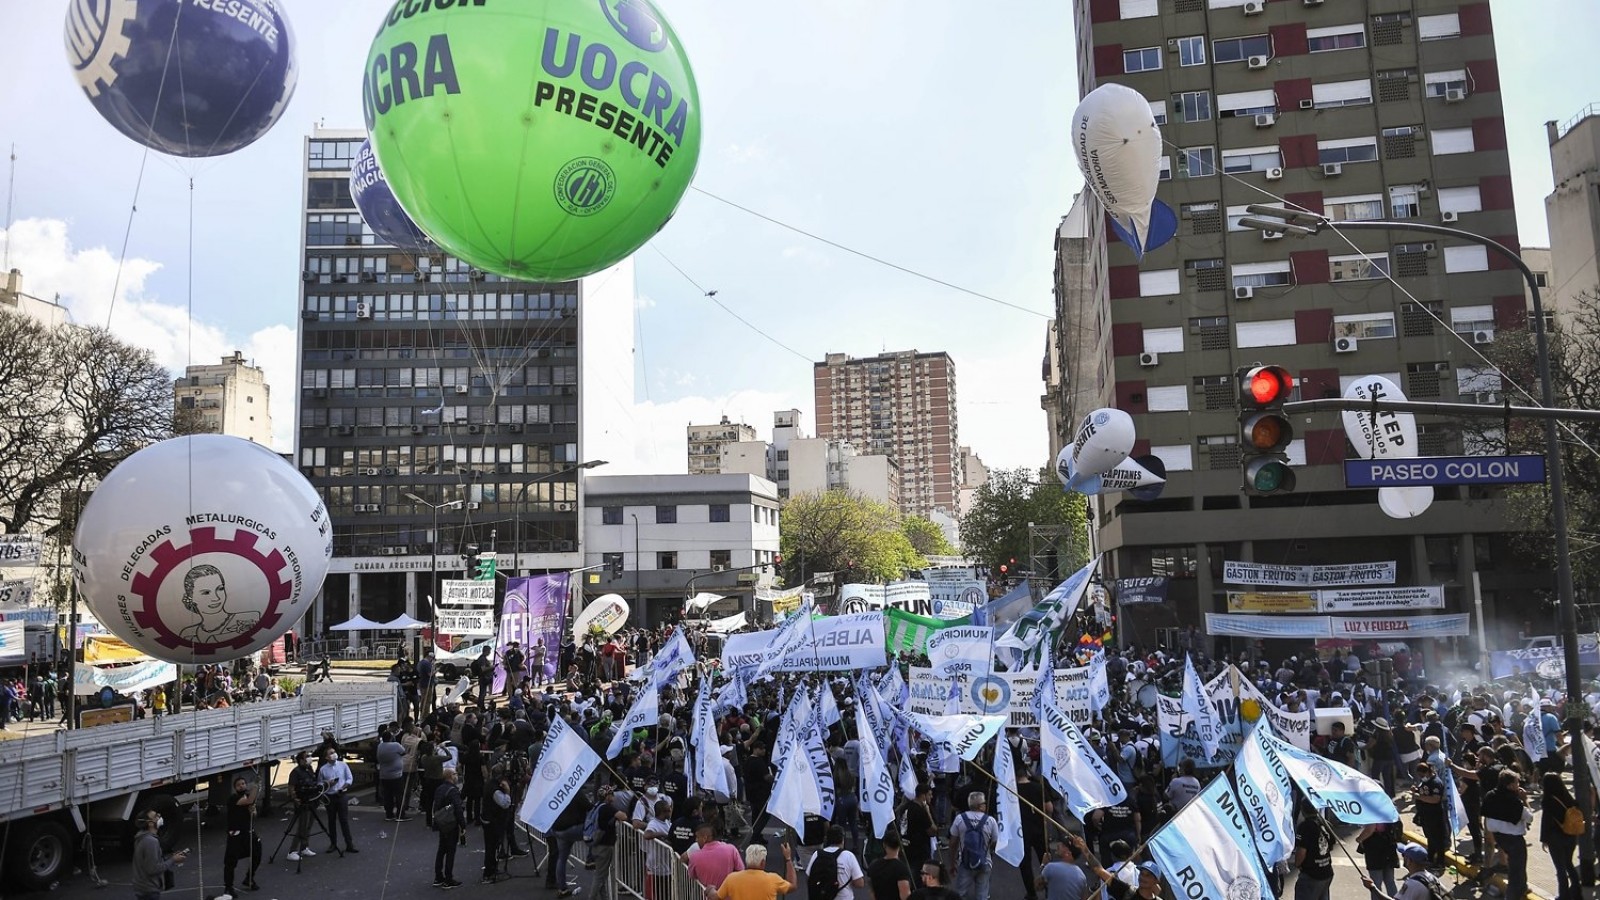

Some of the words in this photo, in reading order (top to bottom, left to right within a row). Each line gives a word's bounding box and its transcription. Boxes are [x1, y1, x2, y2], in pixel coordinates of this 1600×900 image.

[177, 0, 279, 44] RESENTE
[541, 27, 688, 148] UOCRA
[534, 81, 674, 168] PRESENTE
[1081, 115, 1089, 130] DE
[556, 159, 587, 202] CONFEDERACION
[1103, 190, 1118, 205] SER
[1101, 469, 1142, 481] CAPITANES
[1371, 464, 1439, 481] PASEO
[1445, 461, 1519, 479] COLON
[1102, 479, 1113, 488] DE
[1113, 479, 1138, 489] PESCA
[185, 513, 278, 541] METALURGICAS
[121, 525, 172, 582] DELEGADAS
[437, 560, 447, 568] DE
[451, 560, 461, 568] LA
[283, 545, 303, 606] PERONISTAS
[1123, 577, 1154, 588] SUTEP
[1226, 568, 1259, 580] GASTON
[1263, 570, 1297, 581] FRUTOS
[1312, 571, 1346, 582] GASTON
[1349, 569, 1383, 580] FRUTOS
[1351, 590, 1377, 598] mujeres
[117, 594, 145, 639] MUJERES
[458, 617, 482, 629] FRUTOS
[498, 612, 532, 646] TEP
[1344, 621, 1362, 632] LUZ
[1363, 621, 1370, 632] Y
[1371, 620, 1409, 632] FUERZA
[1237, 773, 1275, 843] ROSARIO
